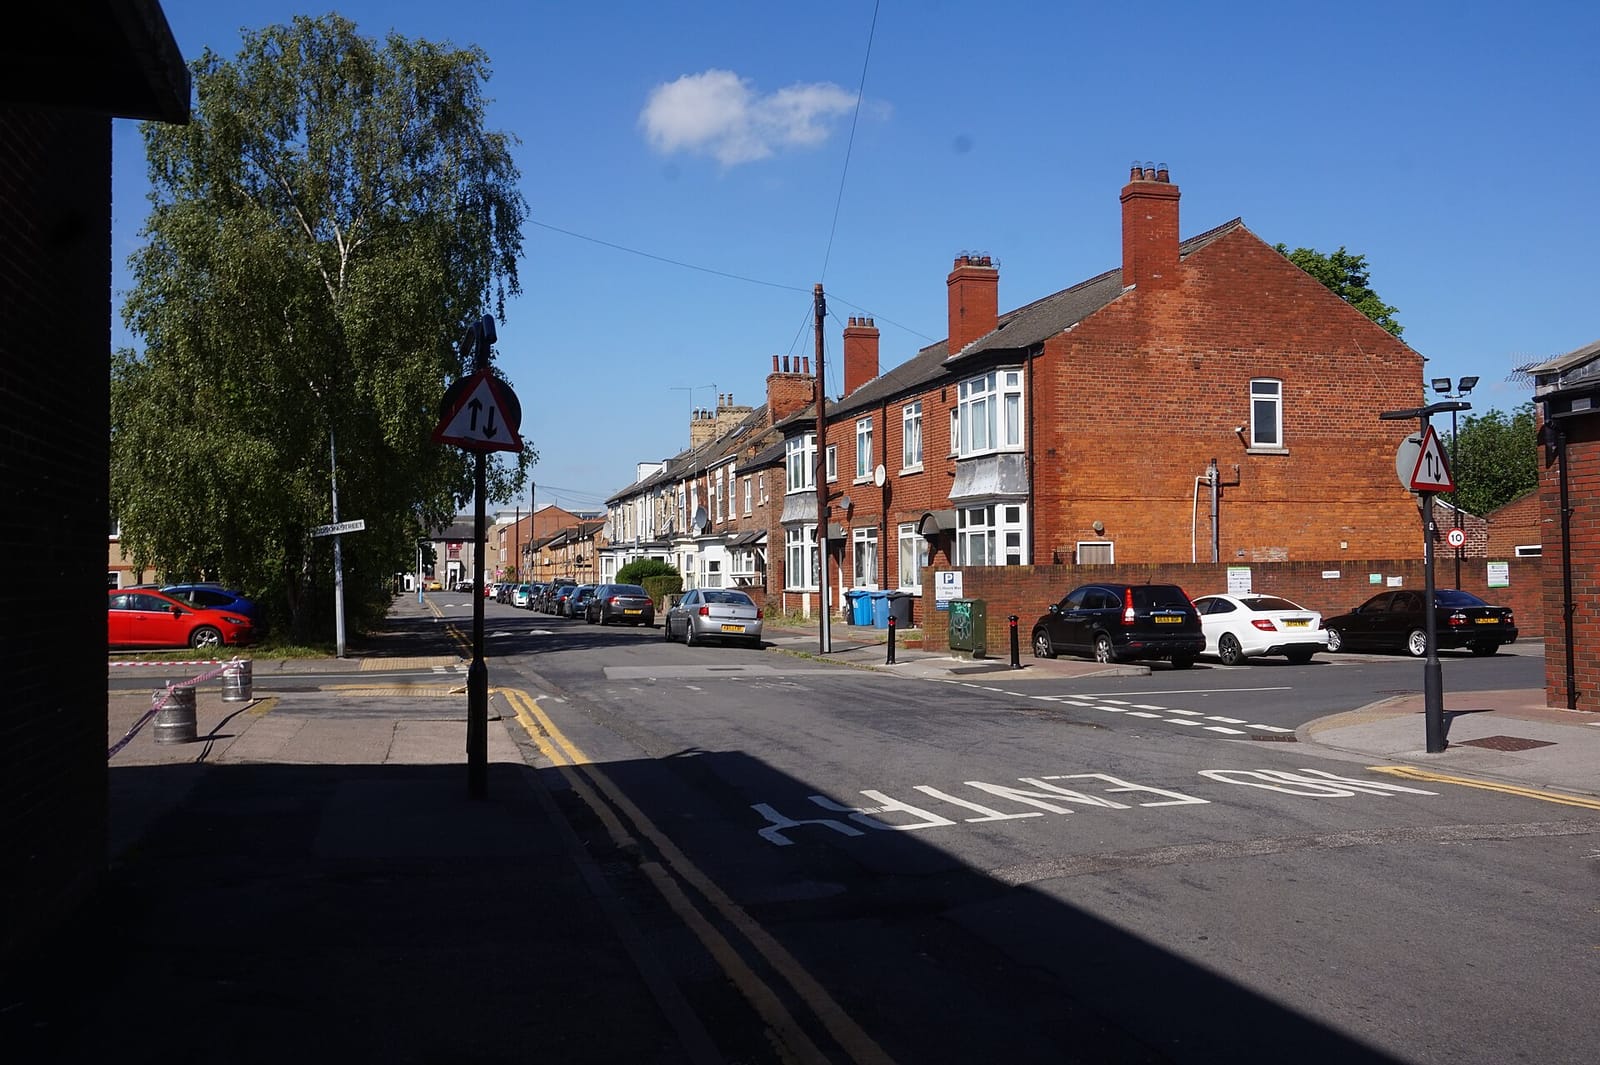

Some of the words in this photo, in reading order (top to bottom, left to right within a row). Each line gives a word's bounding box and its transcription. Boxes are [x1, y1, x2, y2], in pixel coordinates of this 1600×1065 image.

[341, 522, 362, 531] STREET
[1451, 533, 1462, 542] 10
[945, 573, 954, 584] P
[1198, 768, 1440, 797] NO
[751, 773, 1211, 846] ENTRY
